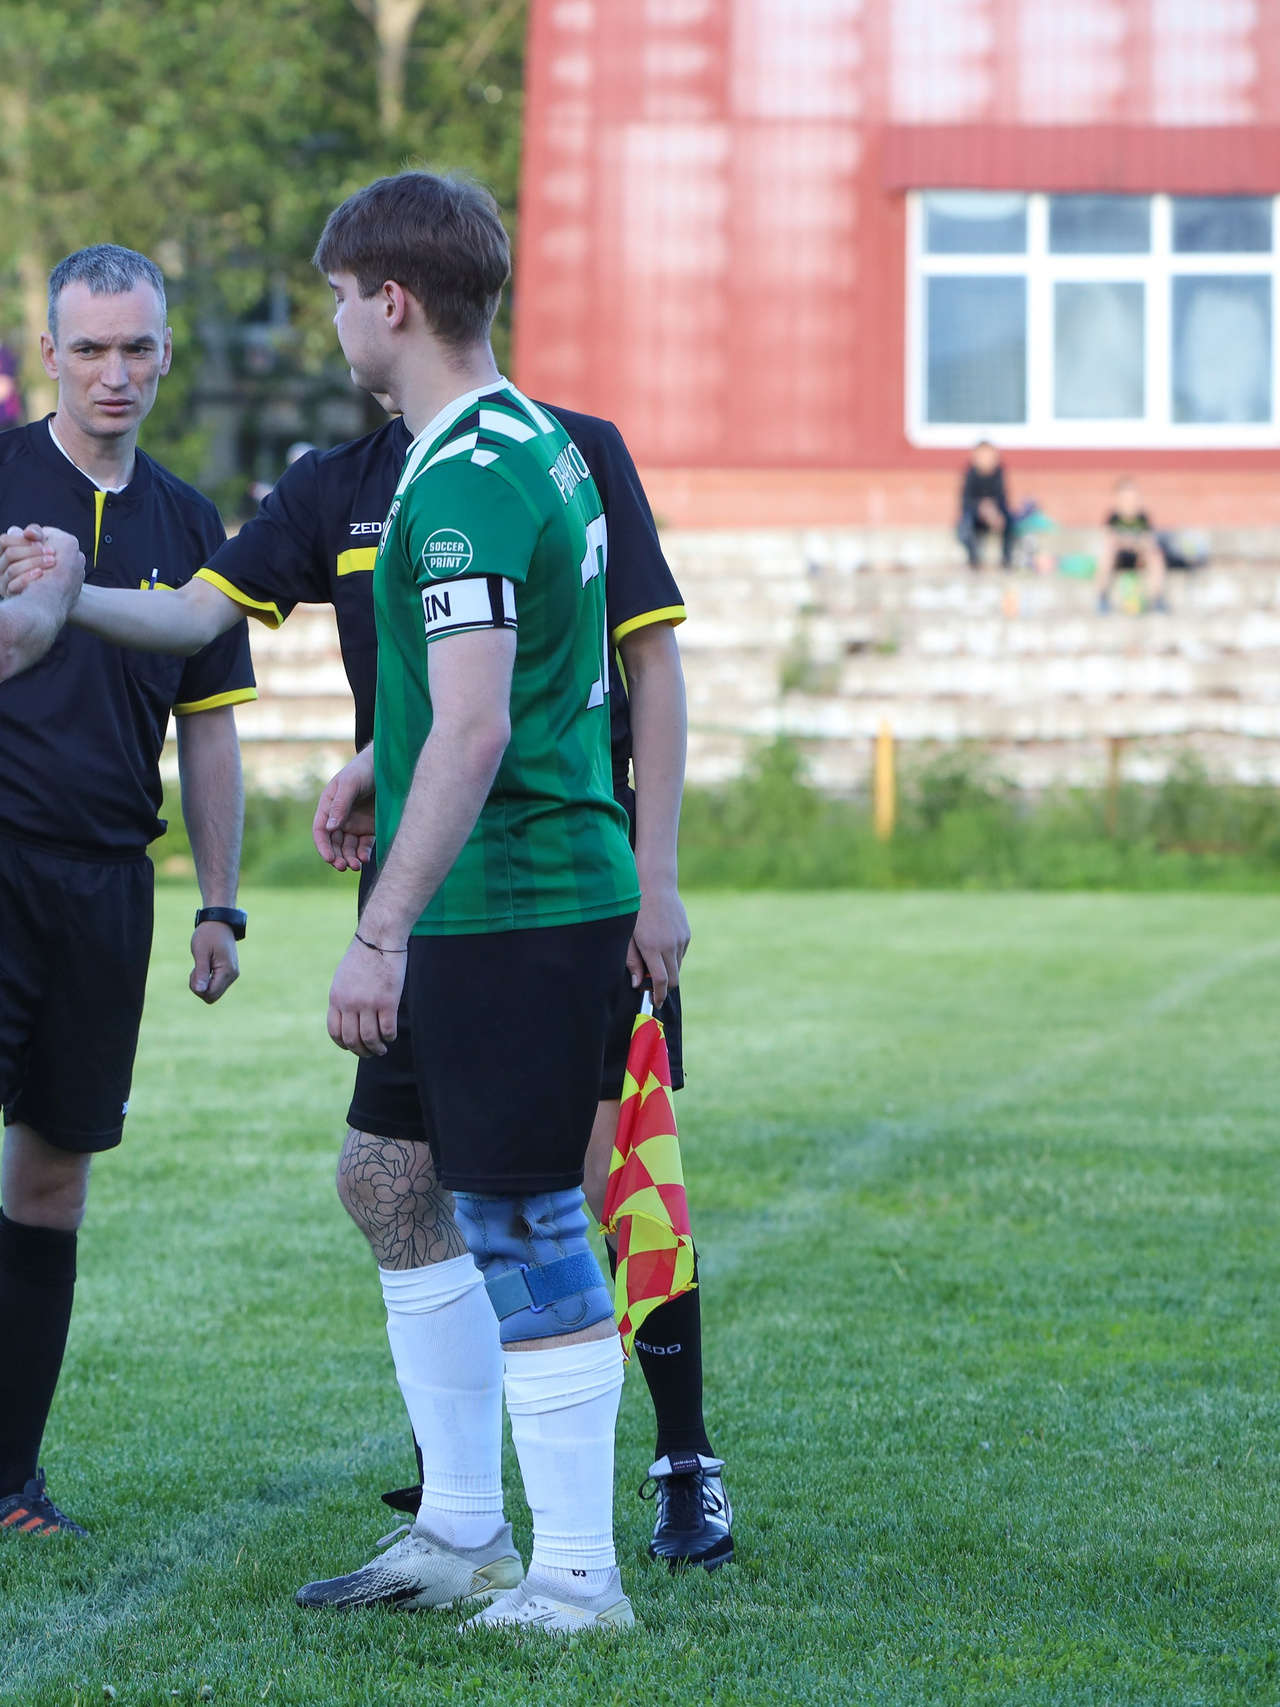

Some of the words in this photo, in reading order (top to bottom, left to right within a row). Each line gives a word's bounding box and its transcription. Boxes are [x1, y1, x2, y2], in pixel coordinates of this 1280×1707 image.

[349, 521, 385, 535] ZED
[429, 541, 464, 552] SOCCER
[430, 557, 462, 568] PRINT
[424, 591, 451, 624] IN
